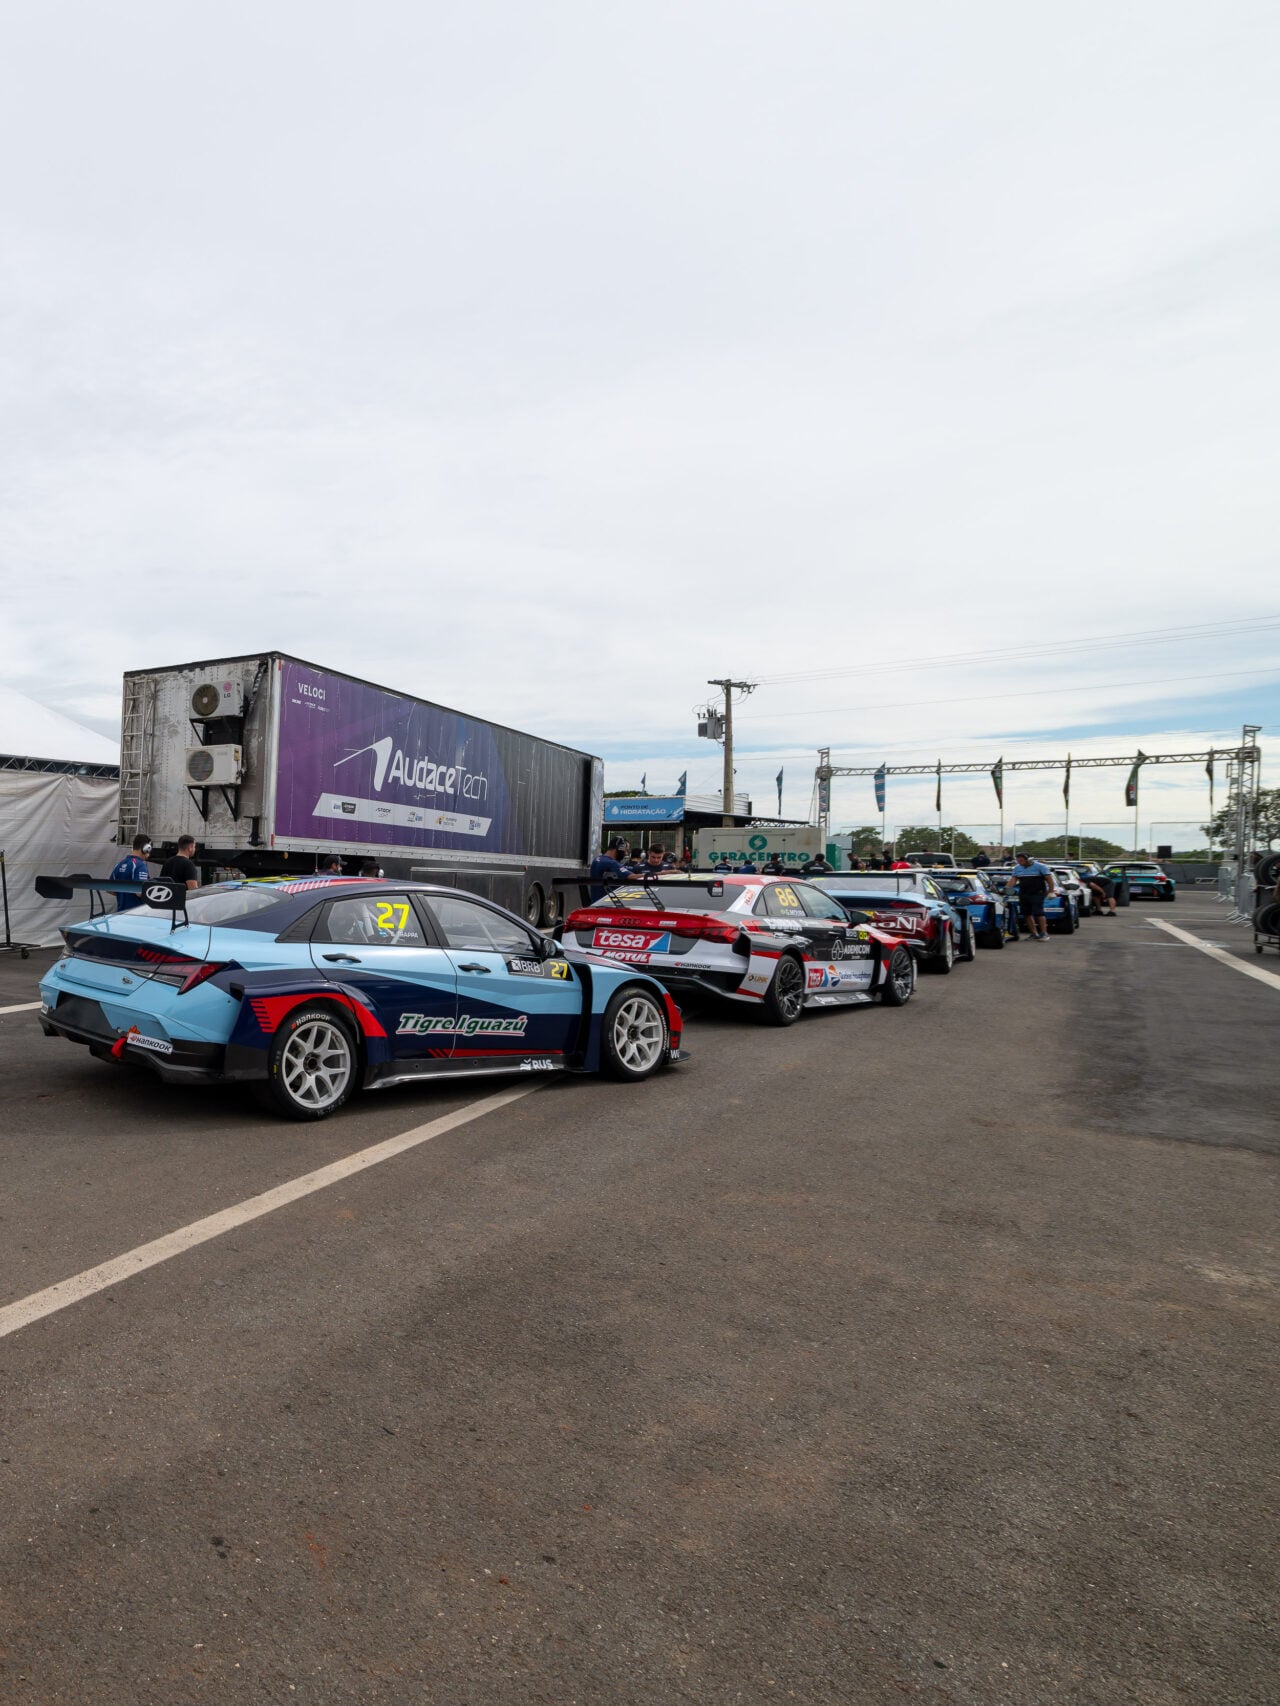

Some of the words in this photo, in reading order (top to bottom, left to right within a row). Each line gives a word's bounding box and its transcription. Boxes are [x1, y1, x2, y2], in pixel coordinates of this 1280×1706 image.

[298, 682, 326, 701] VELOCI
[620, 807, 666, 815] HIDRATAÇÃO
[775, 887, 798, 907] 86
[376, 902, 410, 929] 27
[599, 930, 646, 948] tesa
[605, 951, 648, 962] MOTUL
[521, 960, 540, 973] BRB
[550, 961, 568, 979] 27
[399, 1013, 456, 1036] Tigre
[455, 1015, 528, 1036] Iguazú
